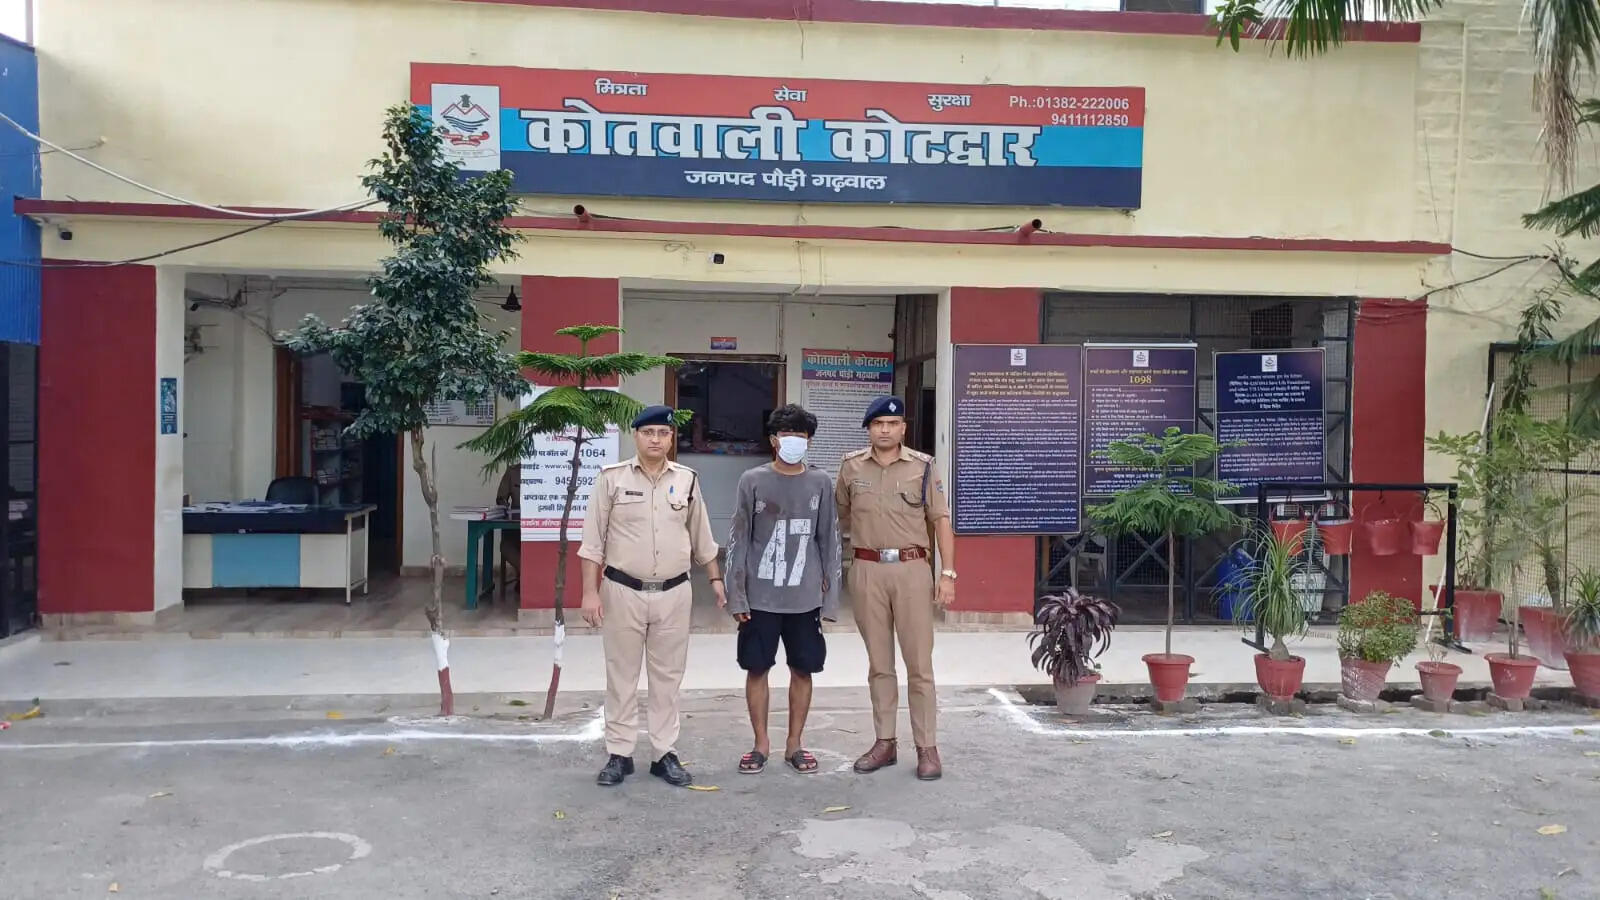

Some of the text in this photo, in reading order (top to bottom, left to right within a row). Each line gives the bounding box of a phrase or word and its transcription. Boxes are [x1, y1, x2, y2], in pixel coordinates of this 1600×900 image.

[594, 78, 972, 111] मित्रता सेवा सुरक्षा
[1009, 95, 1130, 110] Ph.:01382-222006
[1051, 113, 1129, 126] 9411112850
[519, 98, 1042, 167] कोतवाली कोटद्वार
[684, 167, 888, 193] जनपद पौड़ी गढ़वाल
[807, 352, 851, 367] कोतवाली
[1128, 374, 1153, 385] 1098
[580, 448, 606, 458] 1064
[757, 518, 812, 588] 47
